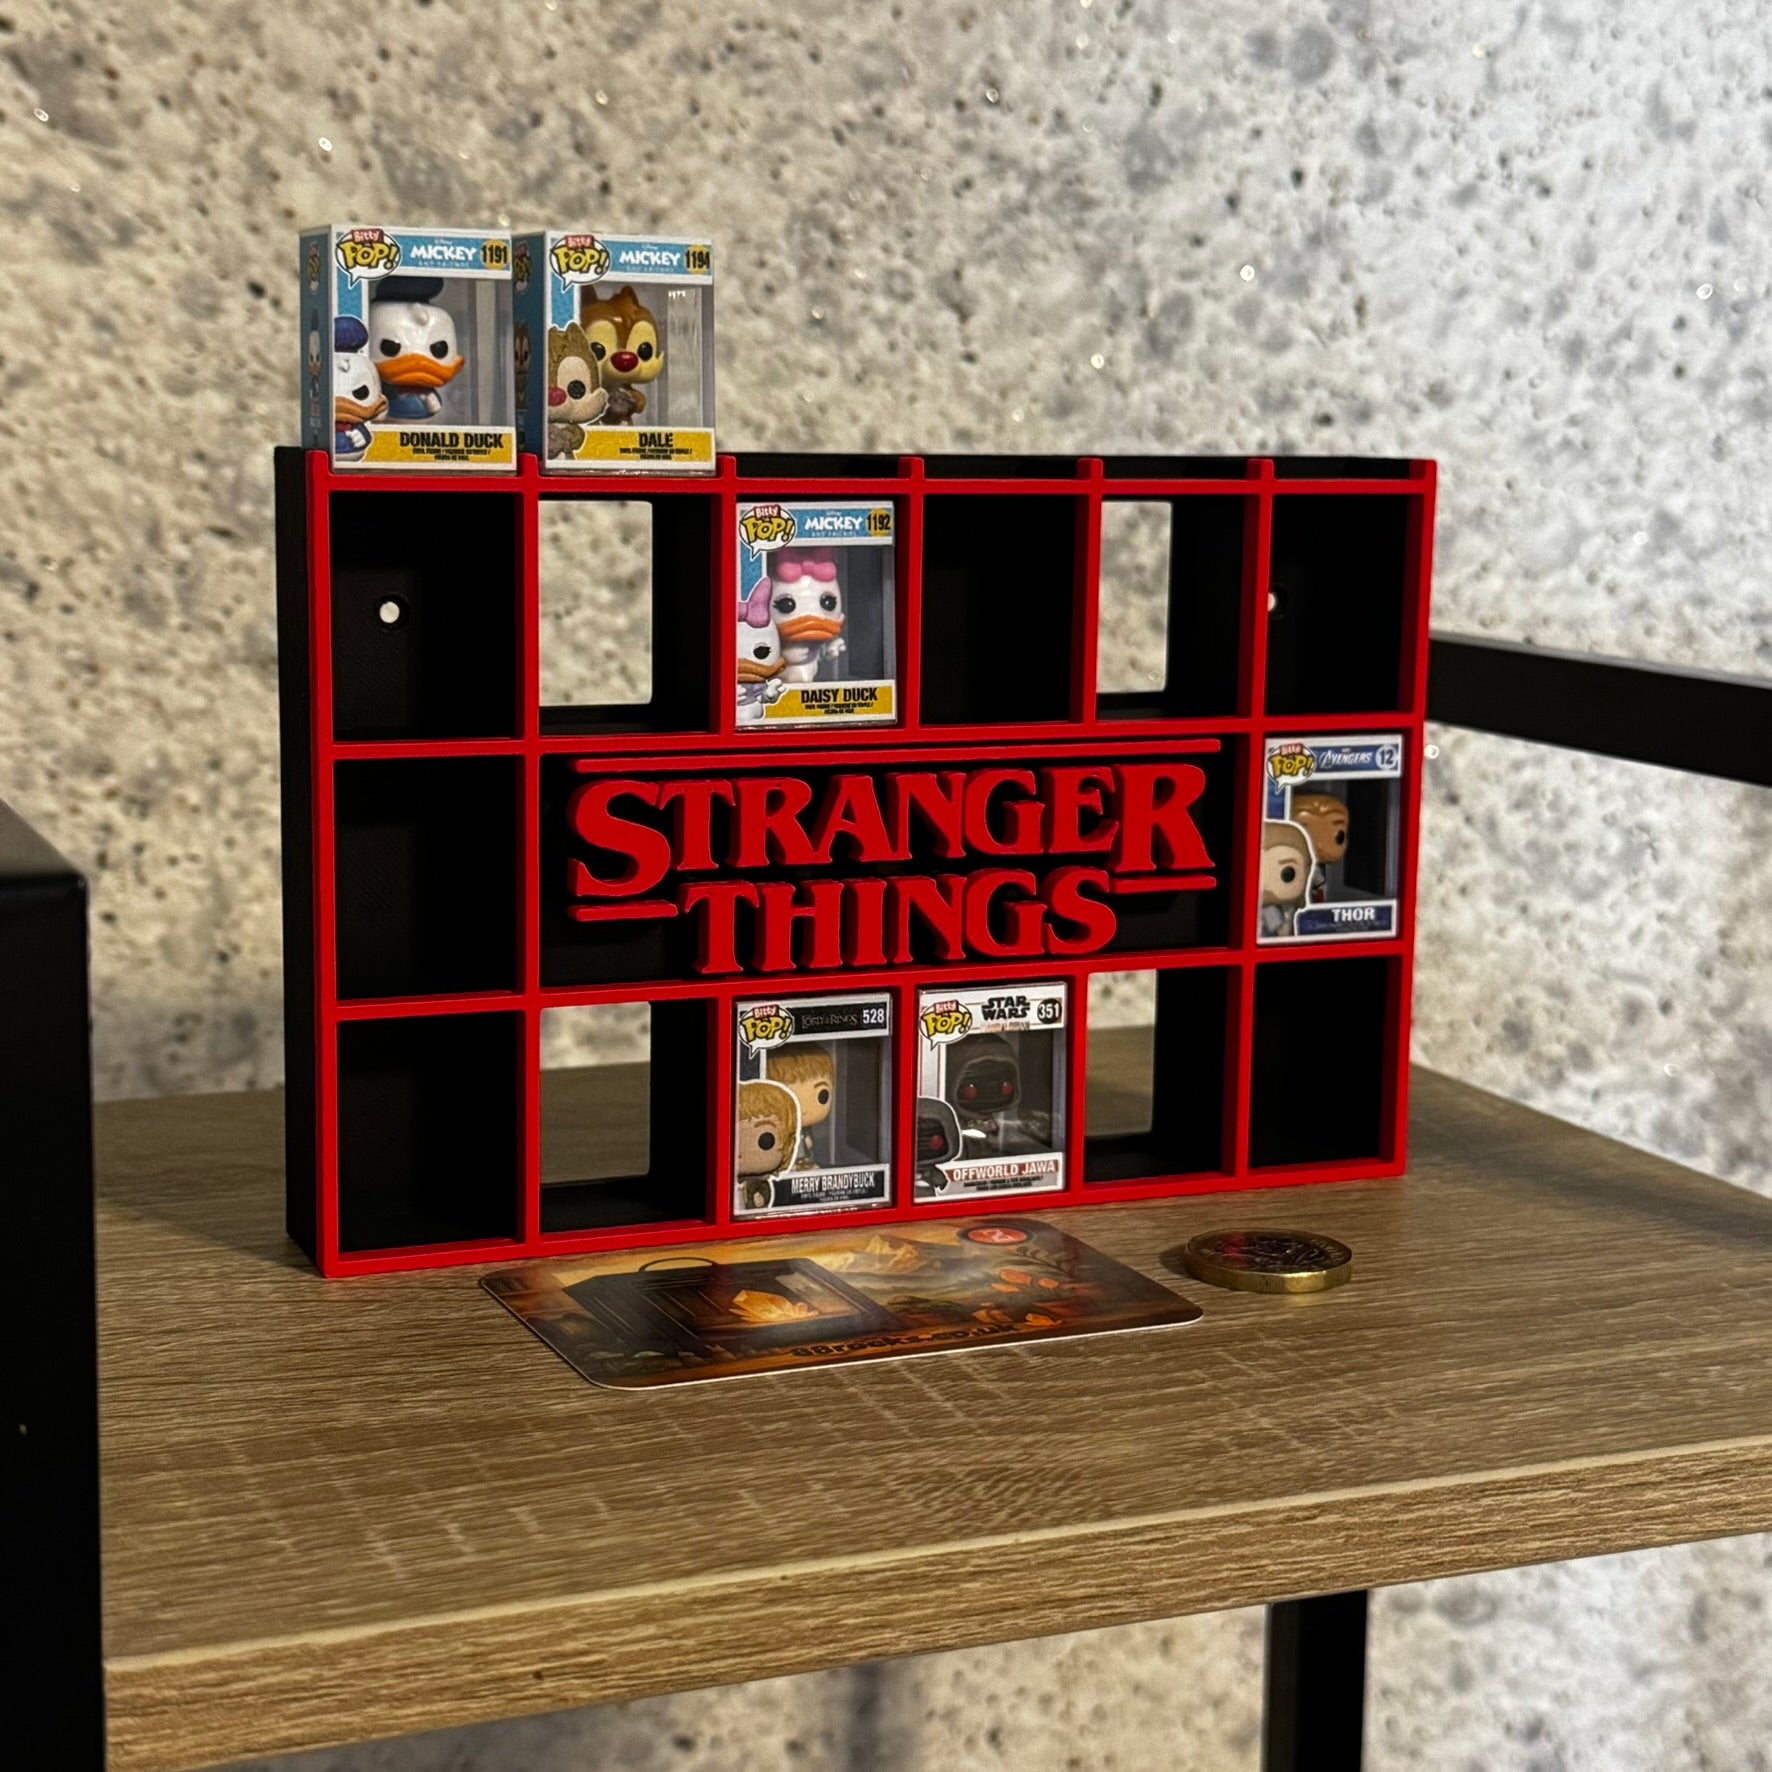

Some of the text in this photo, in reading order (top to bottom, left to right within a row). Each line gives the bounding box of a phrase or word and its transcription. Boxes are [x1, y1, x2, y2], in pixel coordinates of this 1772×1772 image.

[338, 241, 400, 270] POP!
[410, 244, 478, 261] MICKEY
[481, 244, 508, 264] 1191
[553, 248, 609, 274] POP!
[619, 250, 681, 266] MICKEY
[685, 249, 710, 269] 1194
[399, 431, 504, 448] DONALD DUCK
[639, 432, 674, 447] DALE
[755, 505, 780, 517] Bitty
[742, 516, 794, 541] POP!
[804, 516, 863, 531] MICKEY
[867, 513, 891, 530] 1192
[801, 687, 878, 703] DAISY DUCK
[1379, 748, 1395, 766] 12
[1270, 755, 1314, 778] POP!
[567, 763, 1216, 898] STRANGER
[679, 865, 1117, 975] THINGS
[1331, 907, 1375, 923] THOR
[982, 996, 1030, 1009] STAR
[754, 1008, 777, 1017] Bitty
[862, 1008, 885, 1024] 528
[982, 1007, 1030, 1021] WARS
[1038, 1003, 1061, 1020] 351
[742, 1016, 792, 1041] POP!
[924, 1011, 971, 1037] POP!
[953, 1160, 1056, 1181] OFFWORLD JAWA
[791, 1177, 820, 1194] MERRY
[821, 1172, 876, 1191] BRANDYBUCK
